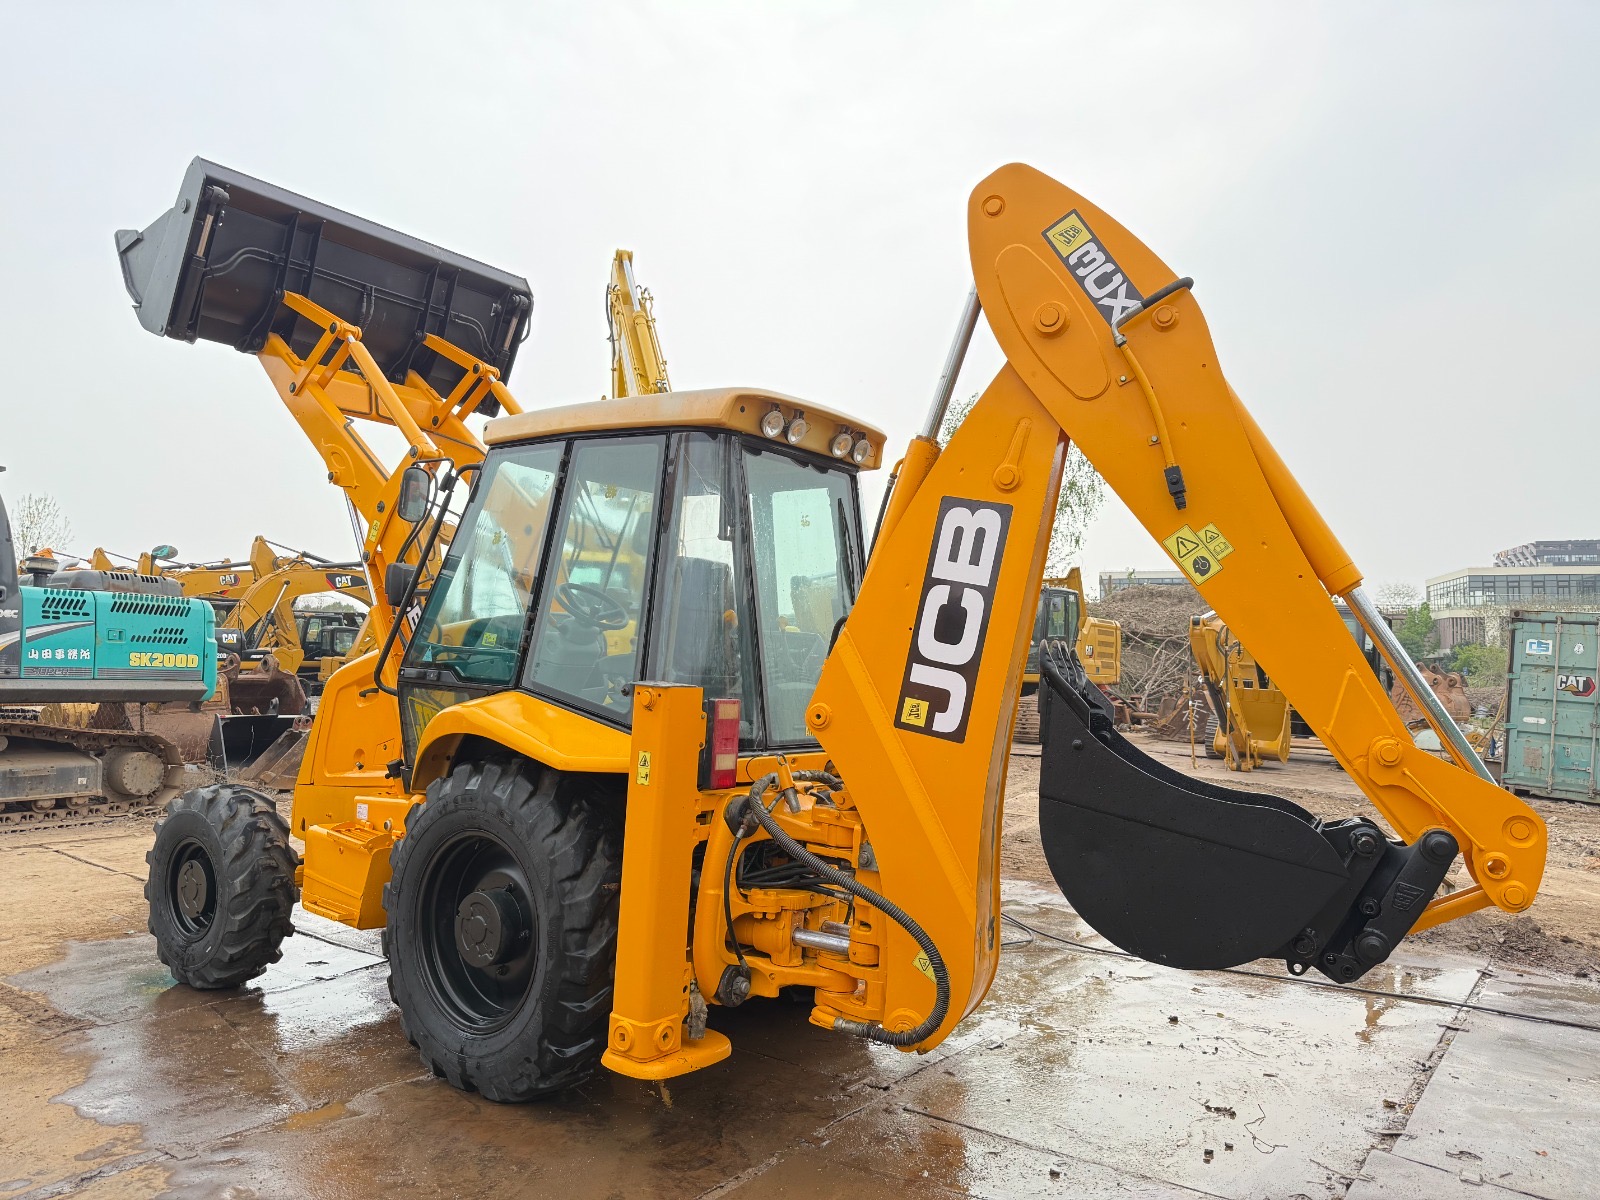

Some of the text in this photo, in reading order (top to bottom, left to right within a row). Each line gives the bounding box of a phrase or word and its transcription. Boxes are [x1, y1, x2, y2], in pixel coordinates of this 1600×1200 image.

[1058, 226, 1080, 245] JCB
[1068, 241, 1141, 324] 3CX
[219, 574, 236, 586] CAT
[335, 575, 352, 587] CAT
[909, 506, 1002, 733] JCB
[222, 633, 238, 644] CAT
[129, 652, 199, 668] SK200D
[1557, 674, 1587, 691] CAT
[908, 702, 921, 720] JCB
